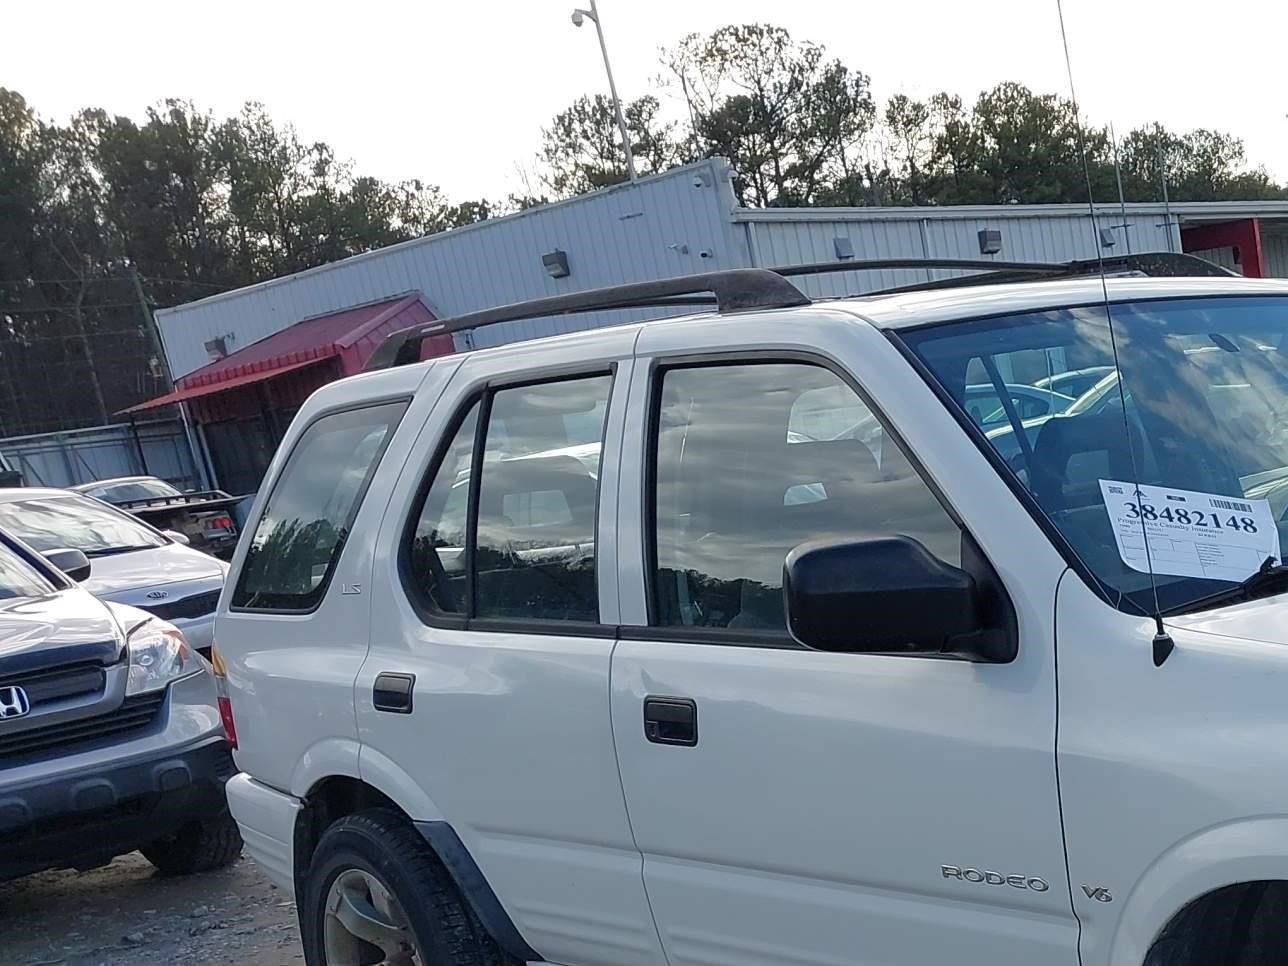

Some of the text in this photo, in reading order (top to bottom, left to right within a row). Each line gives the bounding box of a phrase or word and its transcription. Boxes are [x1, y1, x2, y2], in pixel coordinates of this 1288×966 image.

[1123, 502, 1258, 534] 38482148
[342, 583, 361, 595] LS
[941, 864, 1049, 892] RODEO
[1081, 884, 1113, 903] V6
